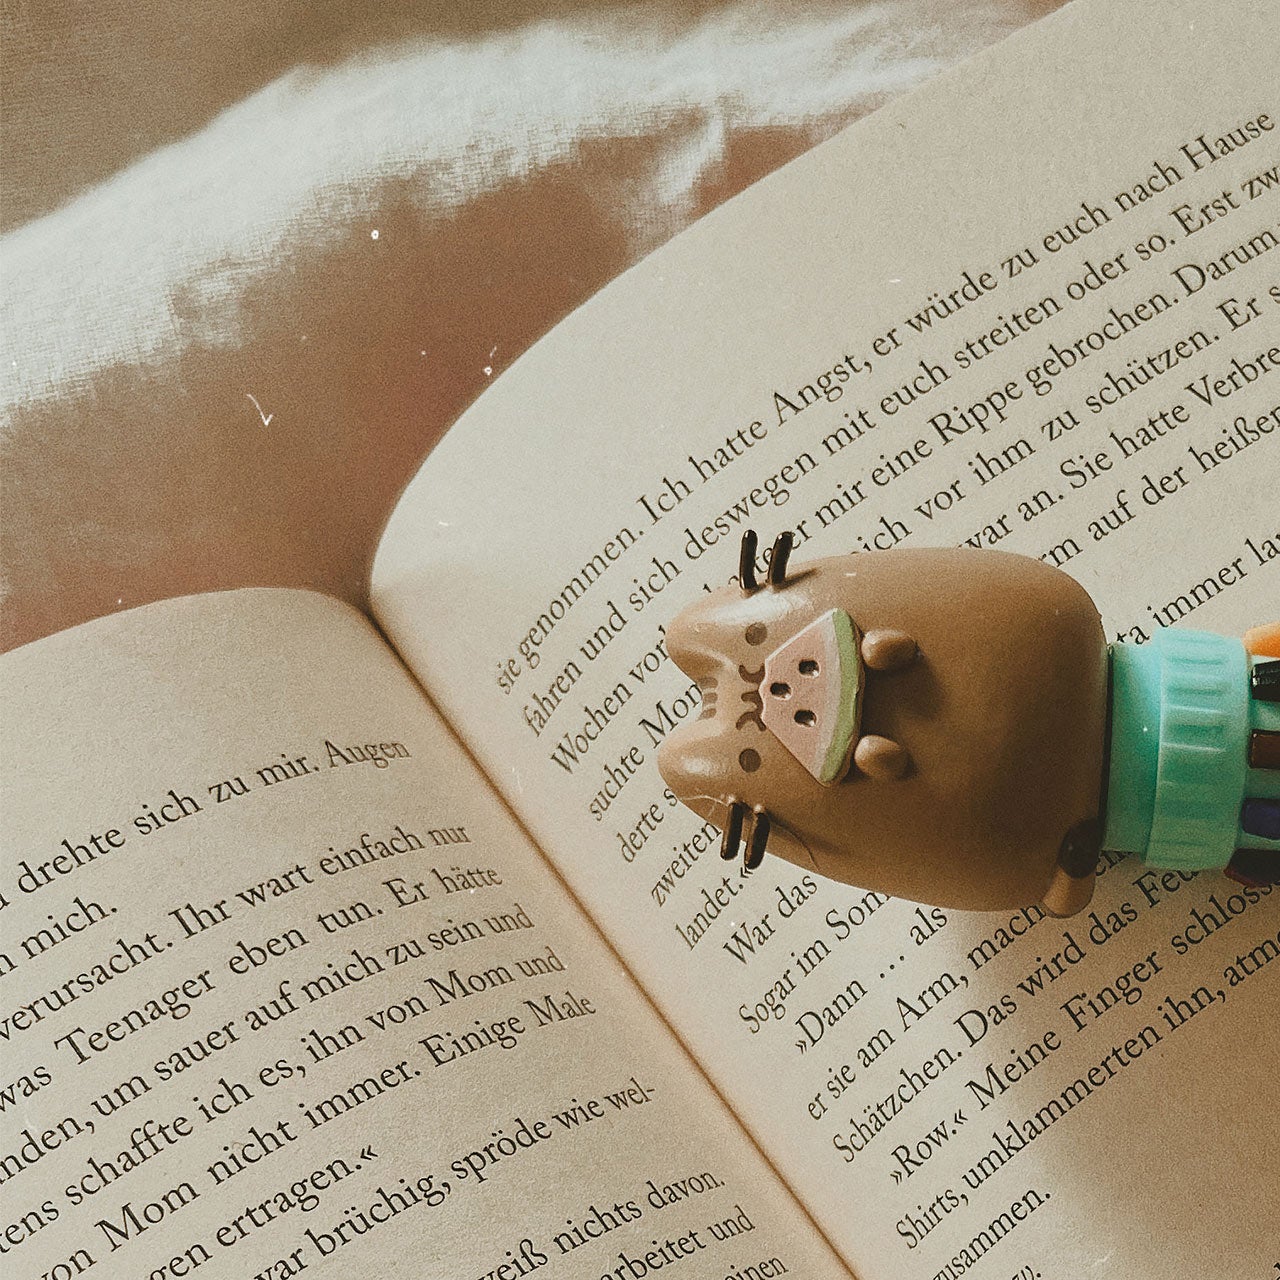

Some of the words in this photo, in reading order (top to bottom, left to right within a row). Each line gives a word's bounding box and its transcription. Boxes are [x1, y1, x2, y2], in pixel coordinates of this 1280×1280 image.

[687, 420, 768, 484] hatte
[773, 354, 873, 427] Angst,
[904, 271, 998, 333] würde
[1178, 113, 1275, 173] Hause
[926, 381, 1024, 446] Rippe
[1025, 293, 1179, 397] gebrochen.
[1170, 230, 1280, 298] Darum
[683, 452, 819, 560] deswegen
[953, 296, 1064, 370] streiten
[1169, 191, 1241, 238] Erst
[1085, 330, 1220, 414] schützen.
[1059, 452, 1114, 490] Sie
[1108, 404, 1191, 460] hatte
[1140, 465, 1190, 506] der
[17, 828, 126, 894] drehte
[133, 789, 204, 836] sich
[255, 753, 320, 787] mir.
[324, 739, 410, 769] Augen
[234, 864, 315, 908] wart
[318, 825, 426, 876] einfach
[53, 969, 217, 1066] Teenager
[316, 901, 384, 934] tun.
[722, 913, 776, 964] War
[738, 968, 797, 1034] Sogar
[794, 980, 869, 1055] »Dann
[153, 1021, 241, 1082] sauer
[832, 1048, 963, 1164] Schätzchen.
[952, 994, 1018, 1048] Das
[889, 1108, 969, 1185] »Row.«
[964, 1030, 1062, 1112] Meine
[1059, 950, 1164, 1033] Finger
[64, 1116, 194, 1206] schaffte
[93, 1182, 201, 1253] Mom
[206, 1120, 299, 1186] nicht
[297, 1060, 422, 1130] immer.
[417, 1016, 526, 1068] Einige
[522, 990, 597, 1028] Male
[895, 1188, 969, 1250] Shirts,
[961, 1025, 1164, 1190] umklammerten
[215, 1144, 379, 1247] ertragen.«
[303, 1174, 452, 1257] brüchig,
[552, 1200, 643, 1255] nichts
